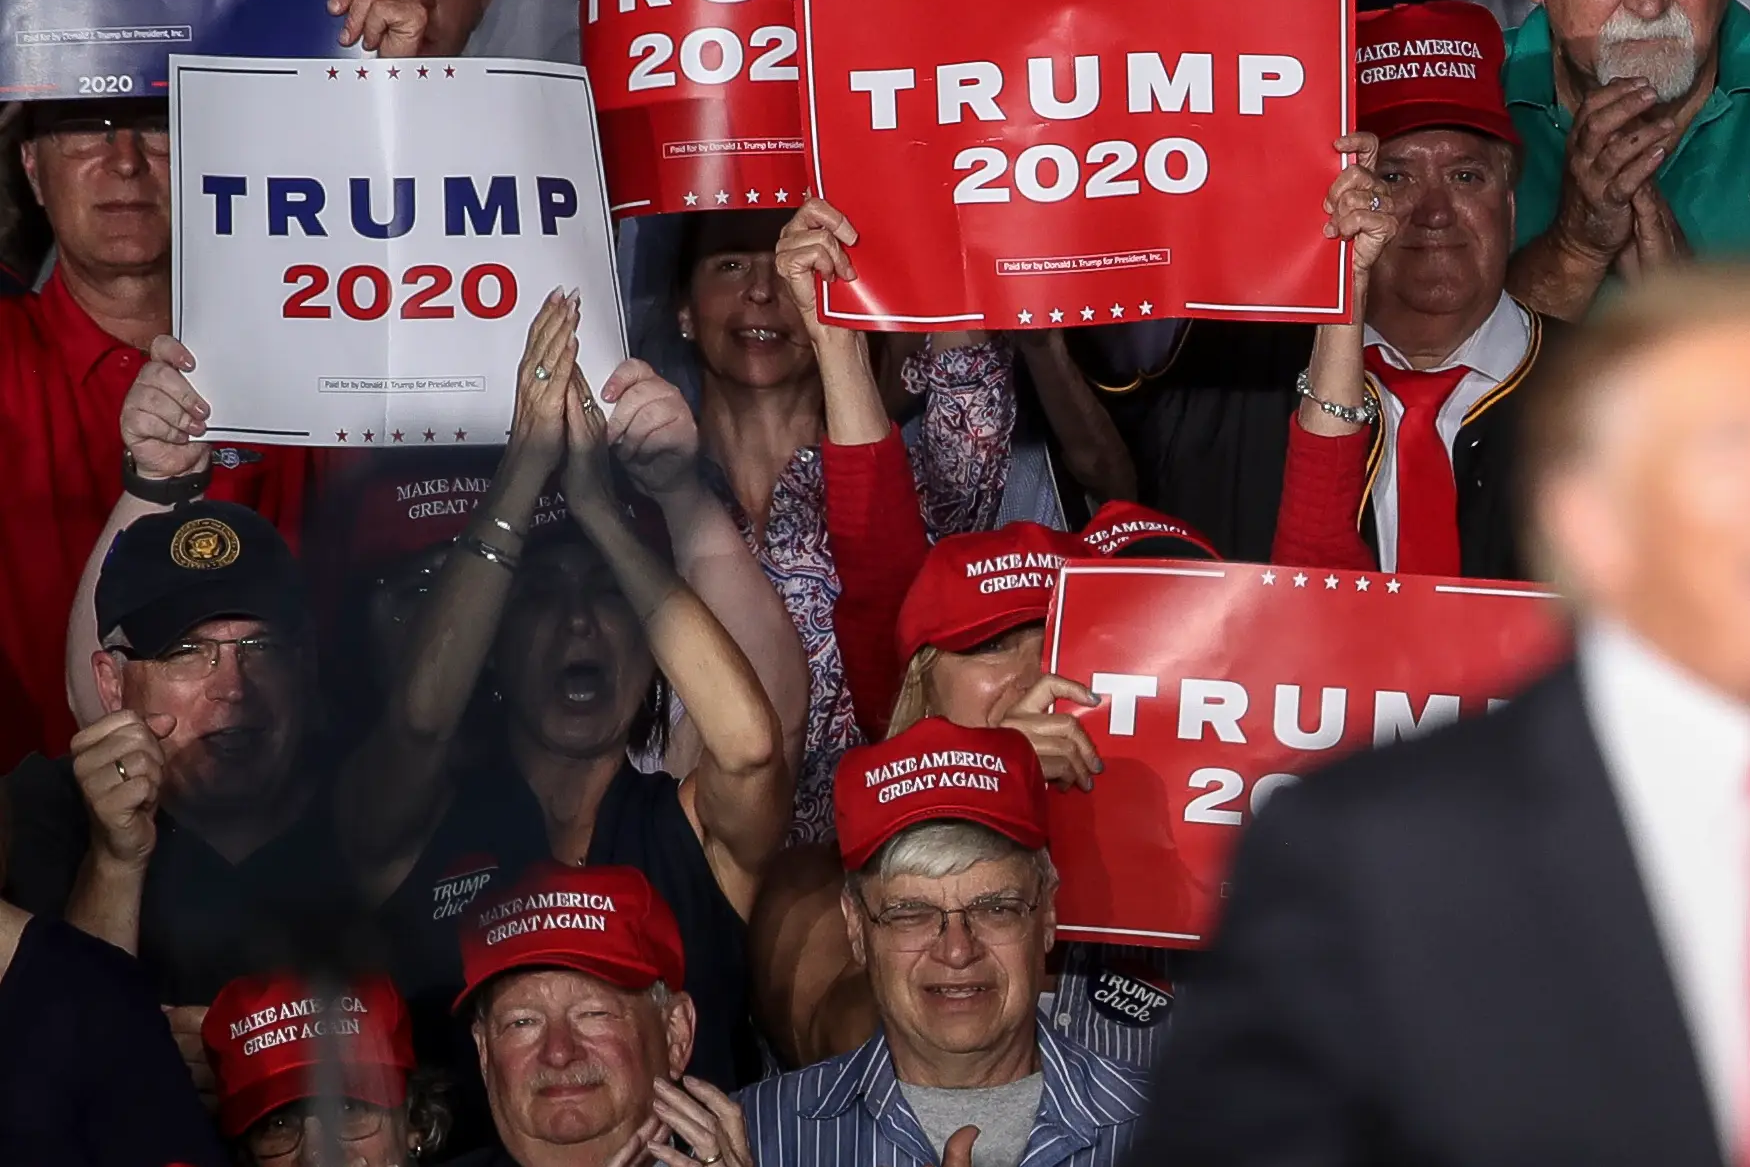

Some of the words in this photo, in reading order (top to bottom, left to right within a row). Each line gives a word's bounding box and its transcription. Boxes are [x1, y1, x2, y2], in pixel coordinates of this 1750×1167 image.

[628, 26, 798, 92] 202
[1403, 39, 1483, 59] AMERICA
[79, 76, 133, 94] 2020
[1361, 62, 1420, 84] GREAT
[1423, 62, 1476, 79] AGAIN
[850, 53, 1304, 130] TRUMP
[953, 138, 1209, 205] 2020
[203, 175, 578, 238] TRUMP
[1021, 262, 1032, 270] for
[1033, 262, 1042, 270] by
[1044, 261, 1071, 269] Donald
[1079, 259, 1101, 268] Trump
[283, 263, 517, 320] 2020
[397, 479, 448, 501] MAKE
[408, 499, 468, 519] GREAT
[966, 553, 1021, 578] MAKE
[980, 573, 1042, 594] GREAT
[865, 757, 919, 788] MAKE
[919, 751, 1006, 774] AMERICA
[879, 774, 936, 804] GREAT
[939, 772, 999, 792] AGAIN
[433, 873, 490, 901] TRUMP
[477, 898, 524, 928] MAKE
[527, 892, 615, 913] AMERICA
[487, 916, 541, 945] GREAT
[543, 913, 606, 931] AGAIN
[1100, 970, 1167, 1008] TRUMP
[1095, 989, 1150, 1022] chick
[230, 1007, 278, 1039] MAKE
[243, 1026, 298, 1056] GREAT
